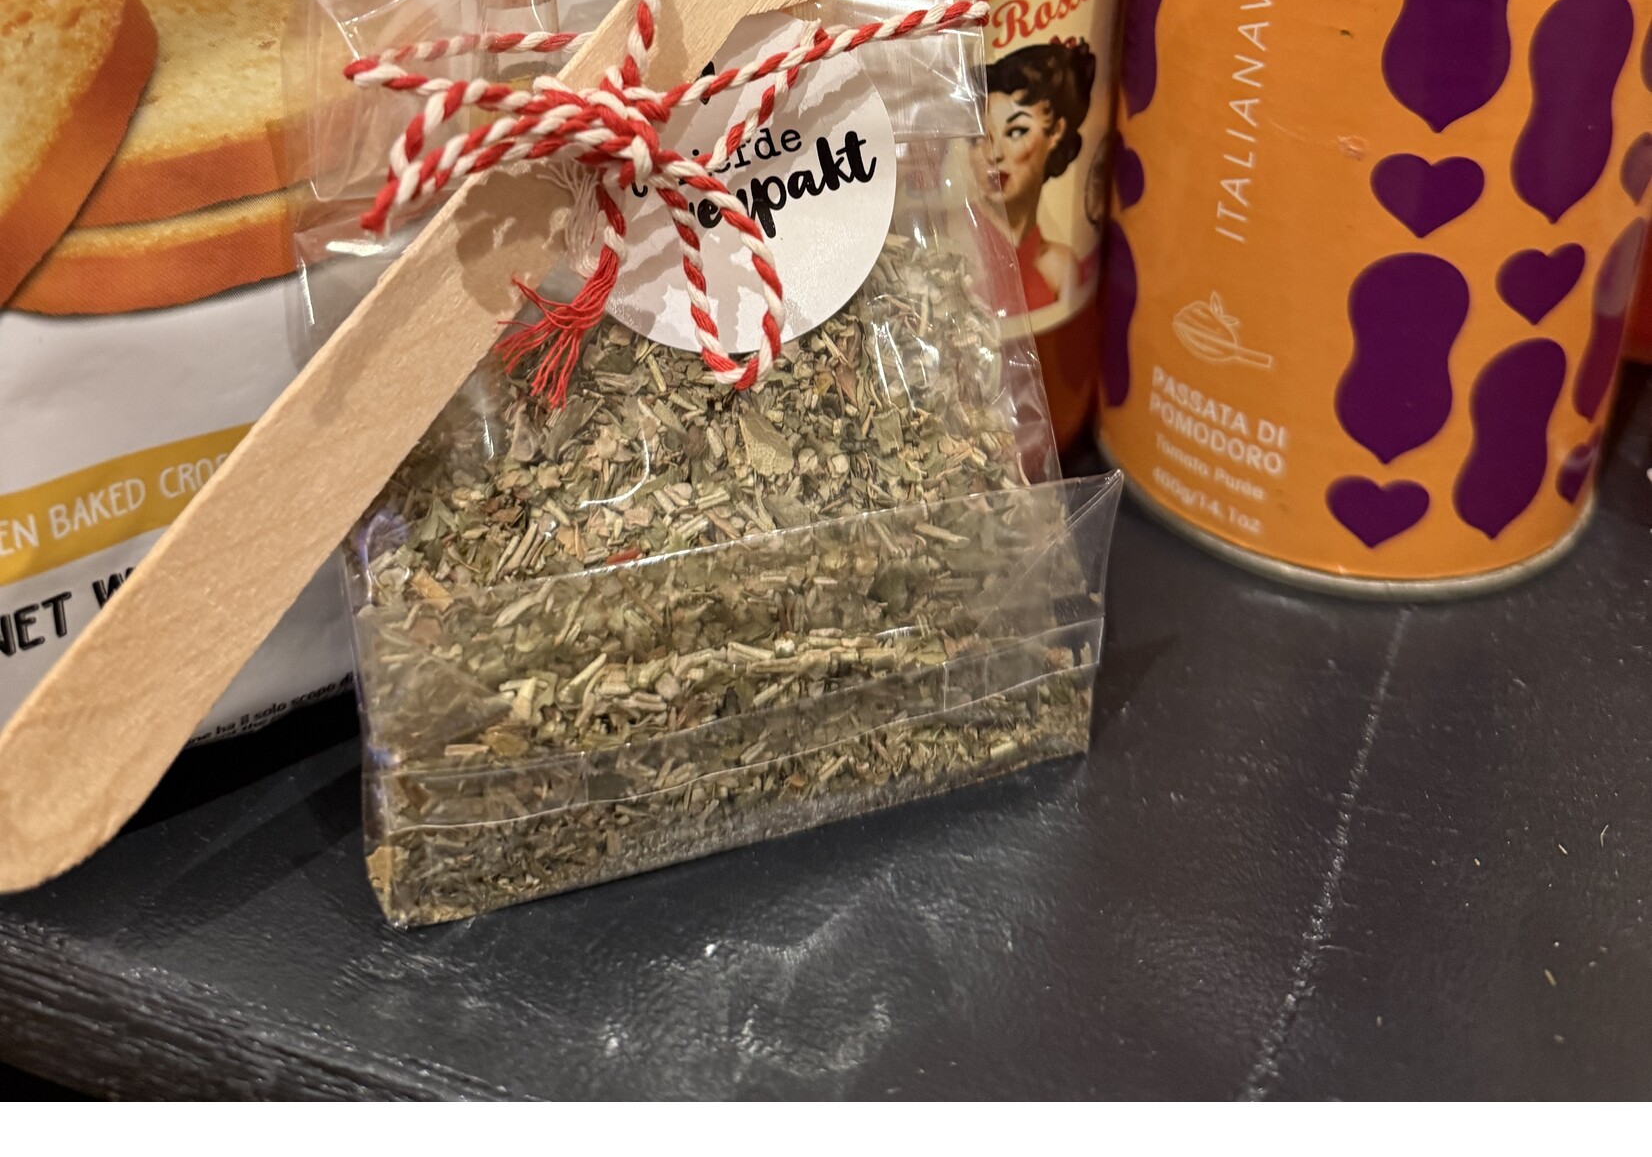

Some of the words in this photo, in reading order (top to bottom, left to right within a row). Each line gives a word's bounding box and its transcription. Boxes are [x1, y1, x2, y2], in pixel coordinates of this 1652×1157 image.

[688, 130, 878, 239] epakt
[1150, 394, 1285, 478] POMODORO
[1152, 365, 1250, 438] PASSATA
[1256, 418, 1288, 451] DI
[48, 477, 147, 541] BAKED
[254, 702, 288, 720] solo
